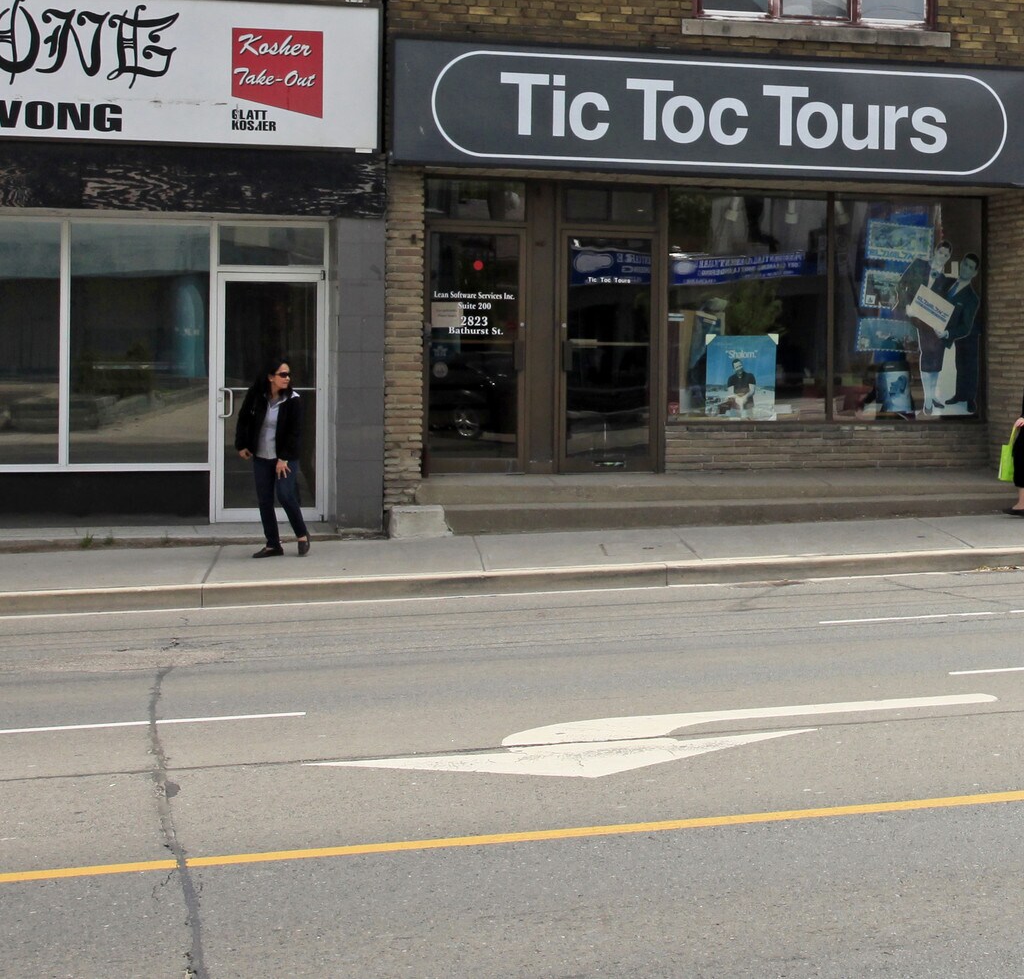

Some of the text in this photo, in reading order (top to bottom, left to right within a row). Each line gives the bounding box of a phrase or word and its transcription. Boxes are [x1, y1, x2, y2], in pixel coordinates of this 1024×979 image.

[238, 33, 312, 57] Kosher
[233, 67, 317, 88] Take-Out
[500, 72, 949, 154] Tic Toc Tours
[433, 290, 516, 300] Lean Software Services Inc.
[458, 302, 492, 310] Suite 200
[460, 315, 488, 326] 2823
[448, 326, 504, 335] Bathurst St.
